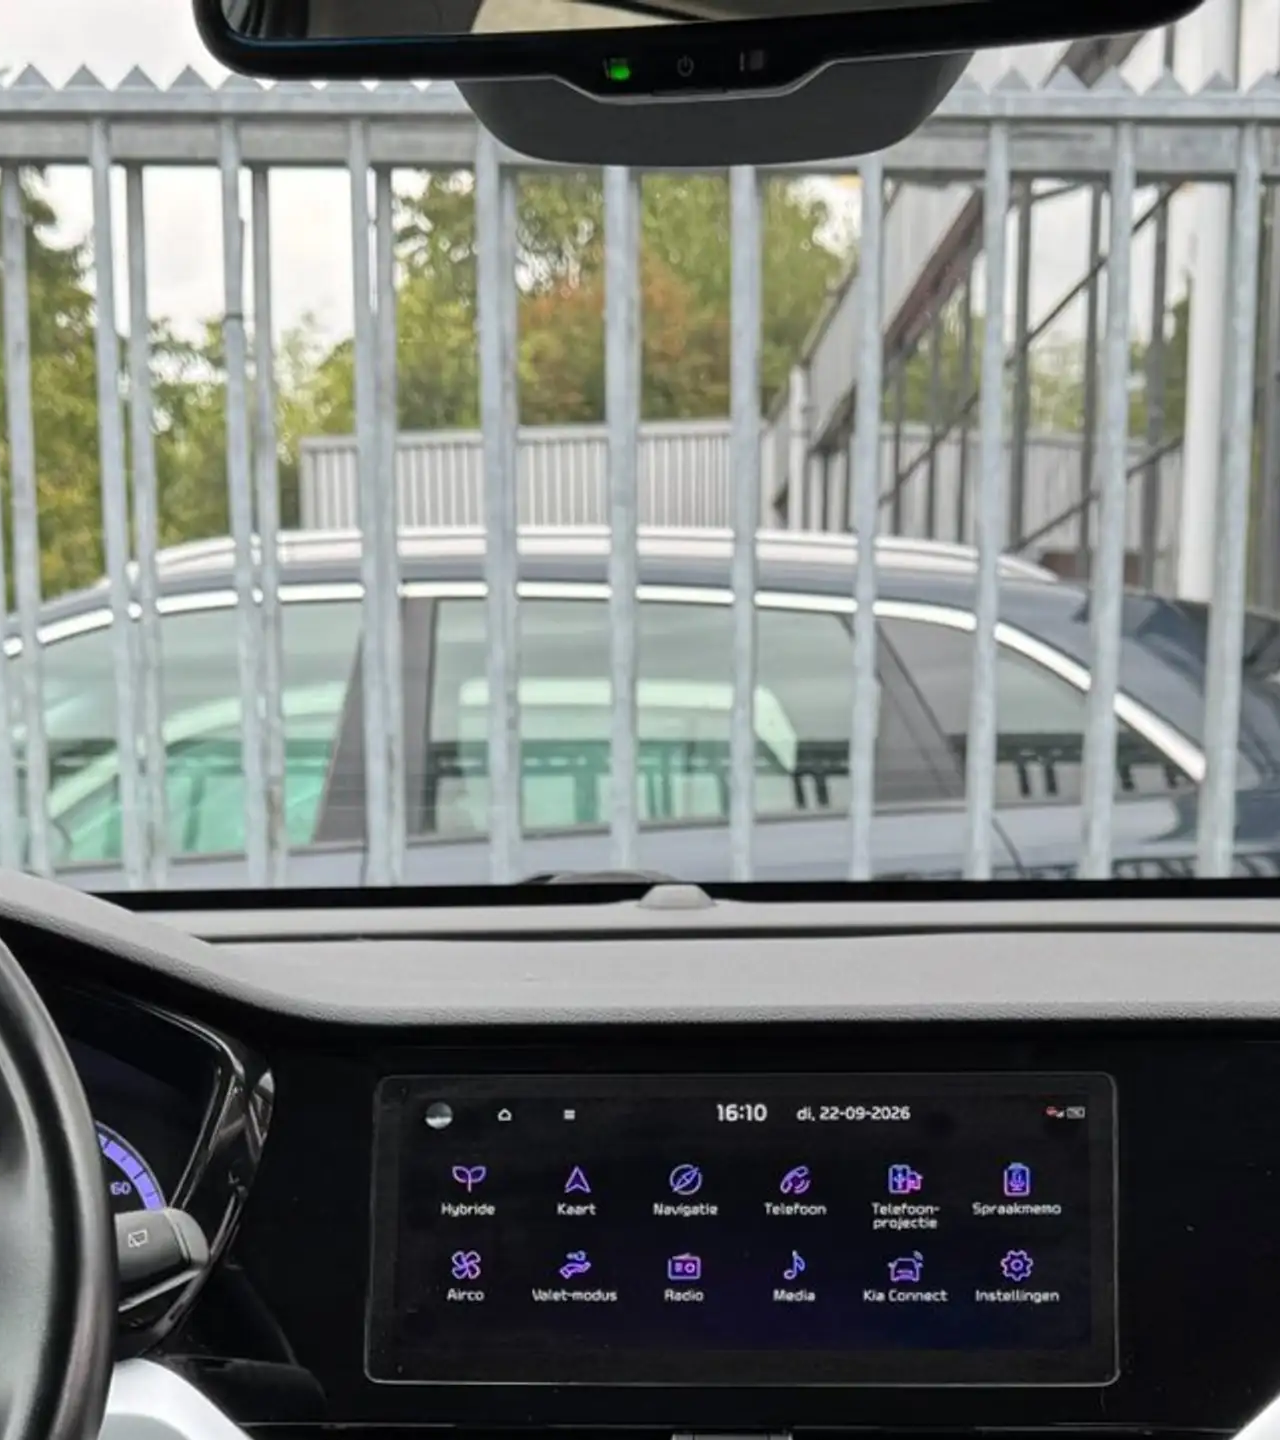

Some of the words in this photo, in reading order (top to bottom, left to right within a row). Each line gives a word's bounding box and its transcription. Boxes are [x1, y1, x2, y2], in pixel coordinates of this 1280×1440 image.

[716, 1103, 768, 1122] 16:10
[819, 1105, 911, 1121] 22-09-2026
[440, 1202, 495, 1217] Hybride
[557, 1202, 596, 1216] Kaart
[653, 1202, 718, 1217] Navigatie
[764, 1201, 827, 1216] Telefoon
[872, 1202, 940, 1216] Telefoon-
[972, 1201, 1062, 1217] Spraakmemo
[872, 1216, 938, 1230] projectie
[447, 1287, 485, 1302] Airco
[531, 1287, 618, 1302] Valet-modus
[664, 1287, 704, 1302] Radio
[773, 1288, 816, 1302] Media
[863, 1288, 885, 1302] Kia
[888, 1288, 948, 1302] Connect
[975, 1288, 1060, 1304] Instellingen
